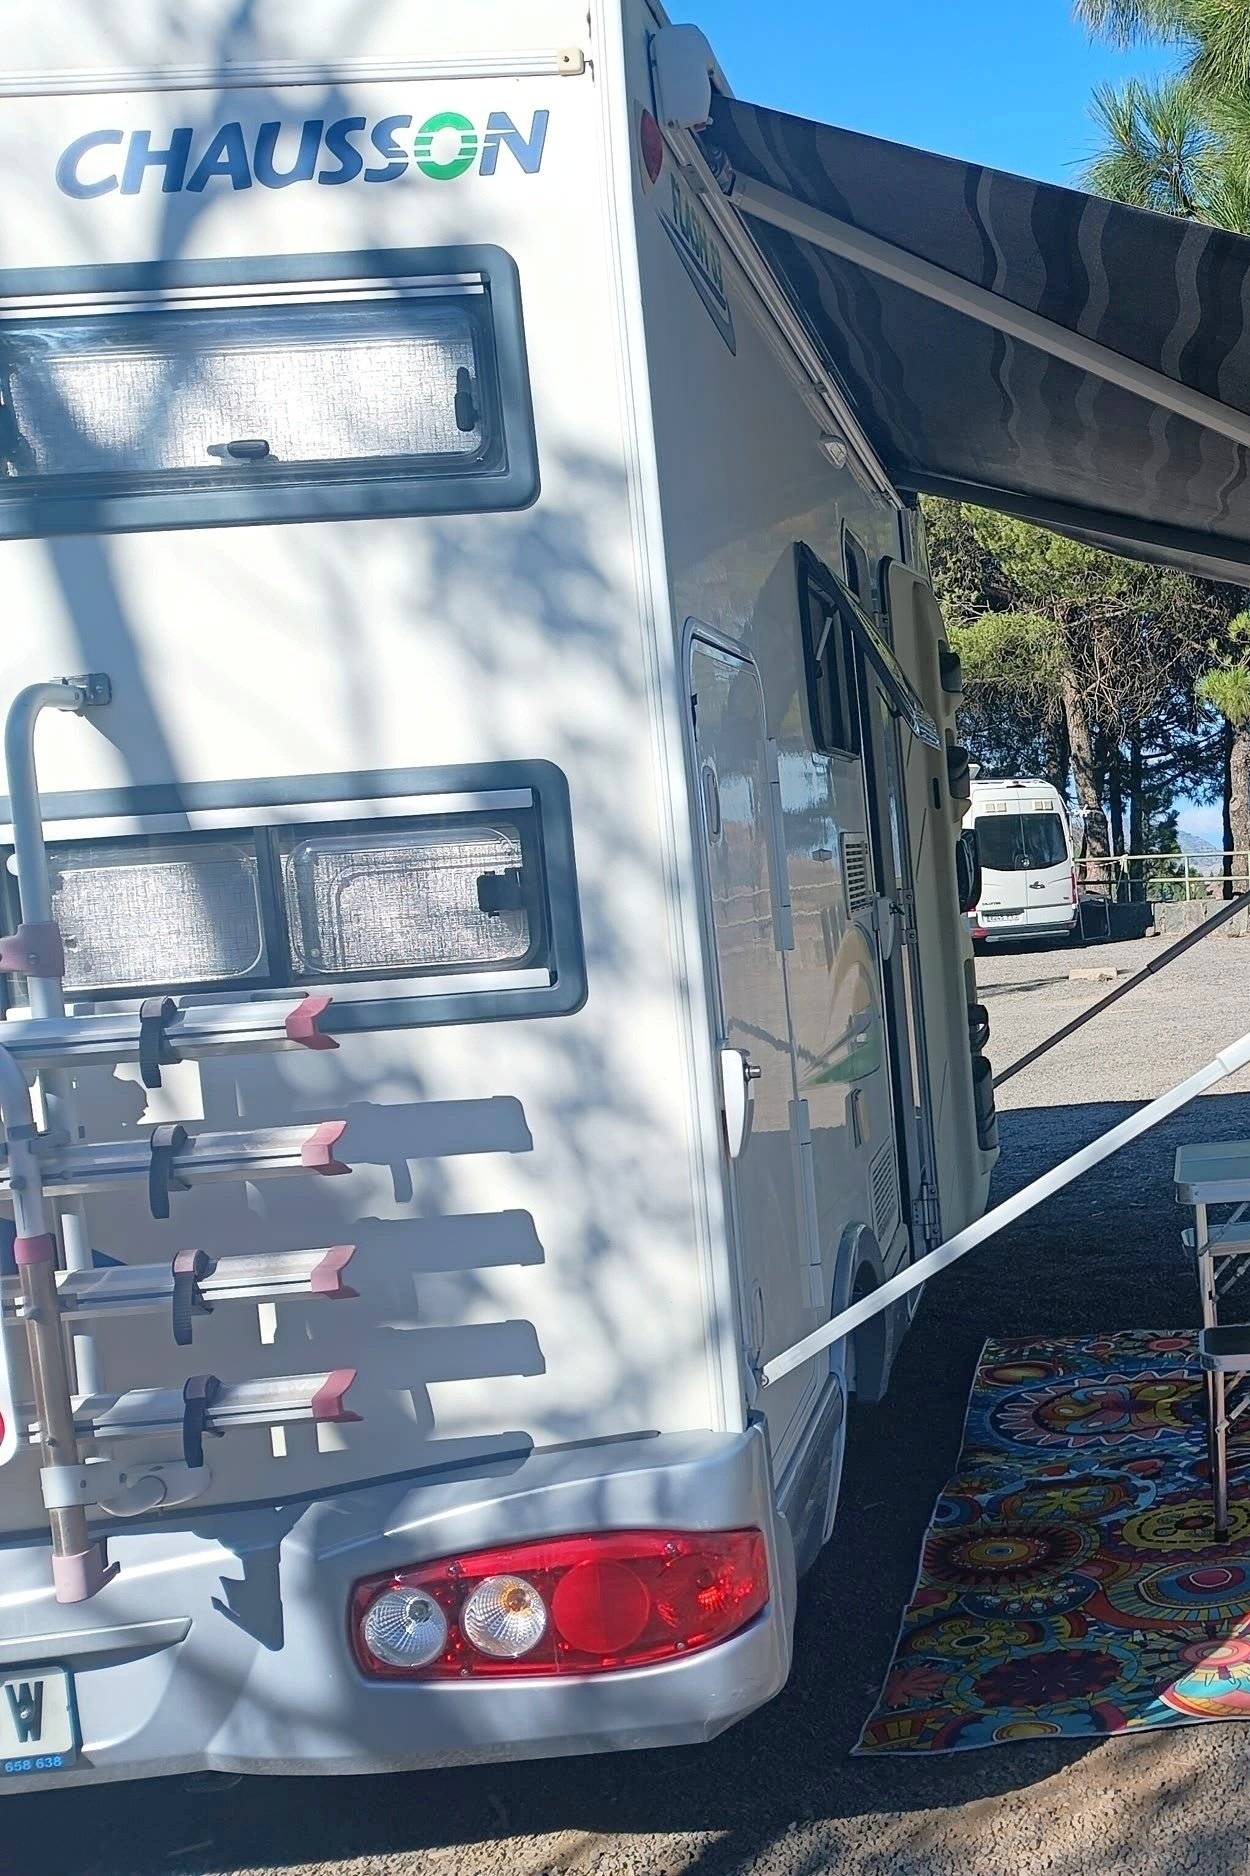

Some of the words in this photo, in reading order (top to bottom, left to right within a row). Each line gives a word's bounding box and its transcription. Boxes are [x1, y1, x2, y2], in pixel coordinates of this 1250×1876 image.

[57, 109, 550, 200] CHAUSSON
[5, 1681, 44, 1743] W
[5, 1761, 31, 1773] 658
[36, 1756, 62, 1768] 638
